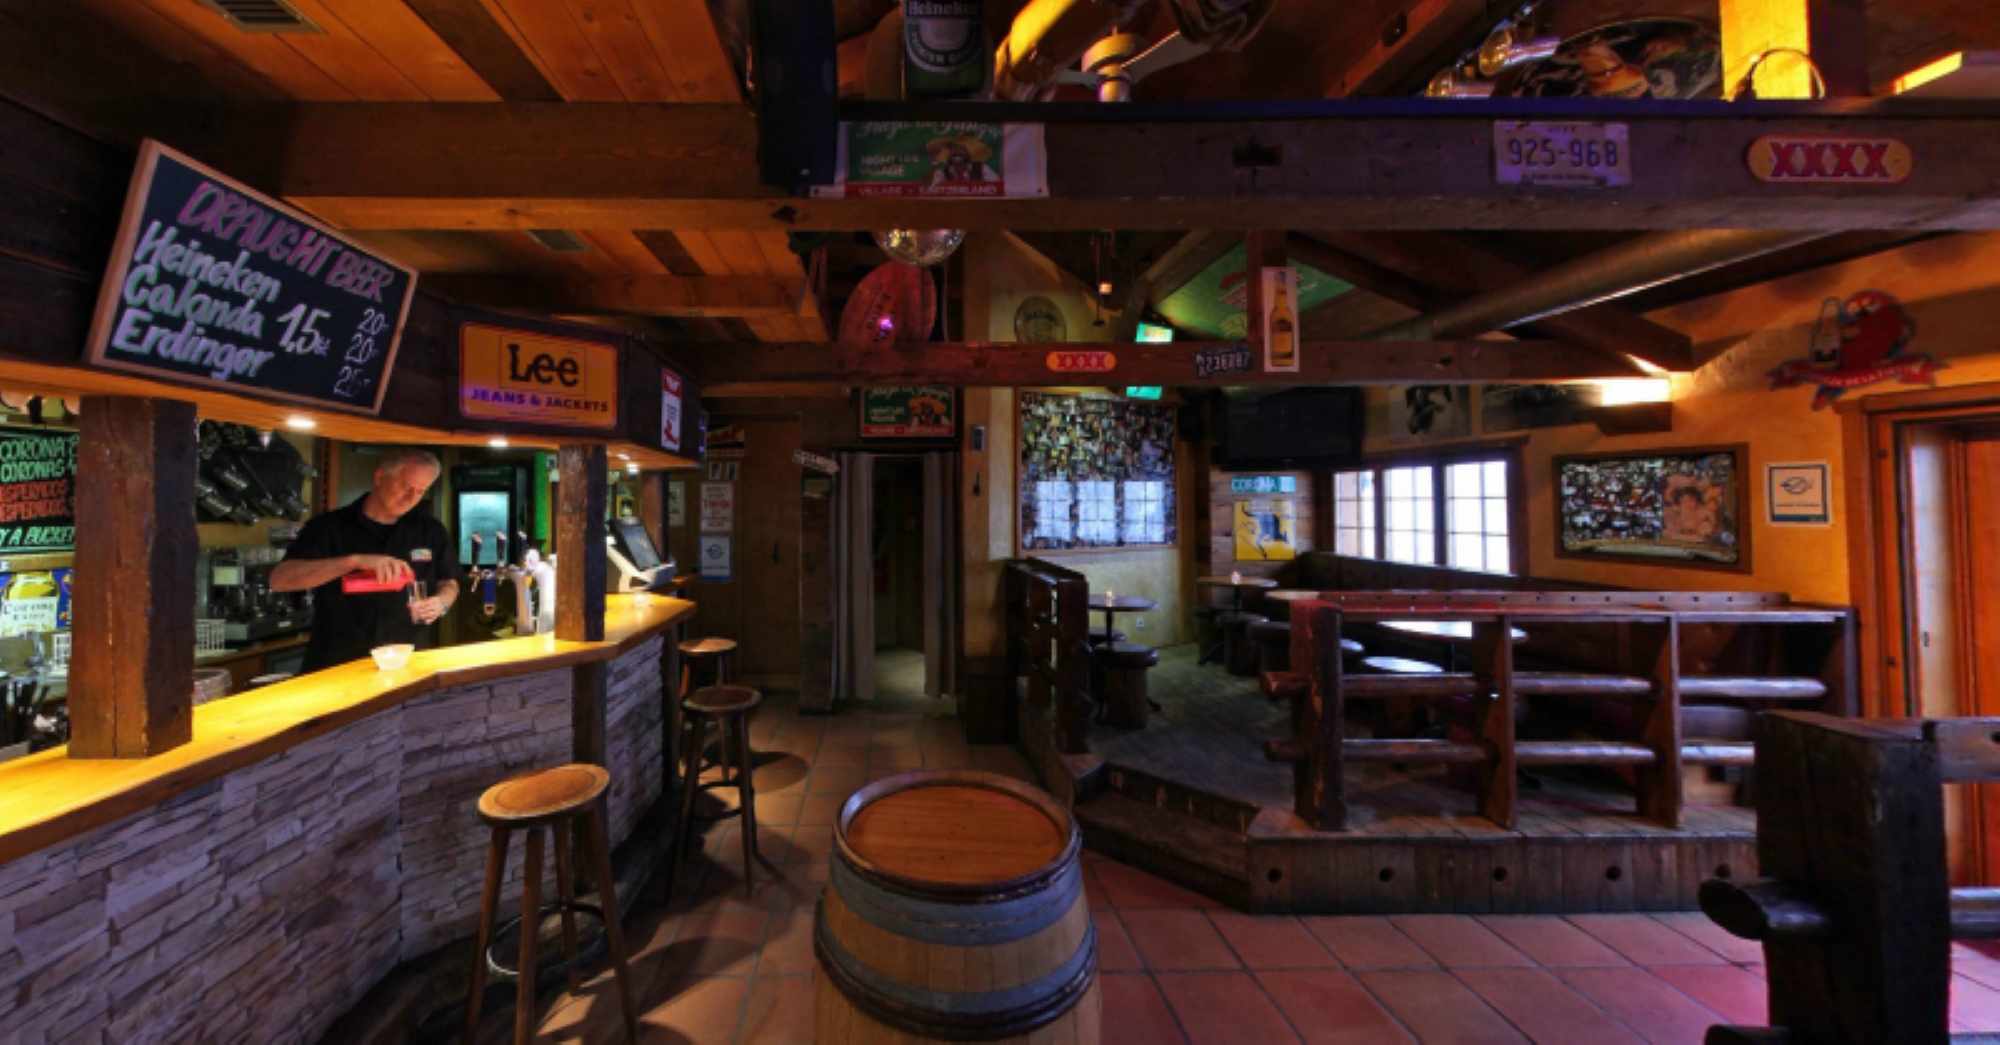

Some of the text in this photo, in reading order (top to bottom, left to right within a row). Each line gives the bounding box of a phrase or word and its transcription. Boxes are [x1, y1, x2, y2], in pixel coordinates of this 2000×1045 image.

[1509, 138, 1618, 168] 925-968
[1769, 141, 1892, 177] XXXX
[176, 180, 396, 303] DRAUGHT BEER
[133, 220, 283, 303] Heineken
[111, 308, 275, 381] Erdinger
[1056, 353, 1107, 368] XXXX
[506, 343, 580, 388] Lee
[471, 389, 608, 412] JEANS & JACKETS
[9, 526, 23, 546] A
